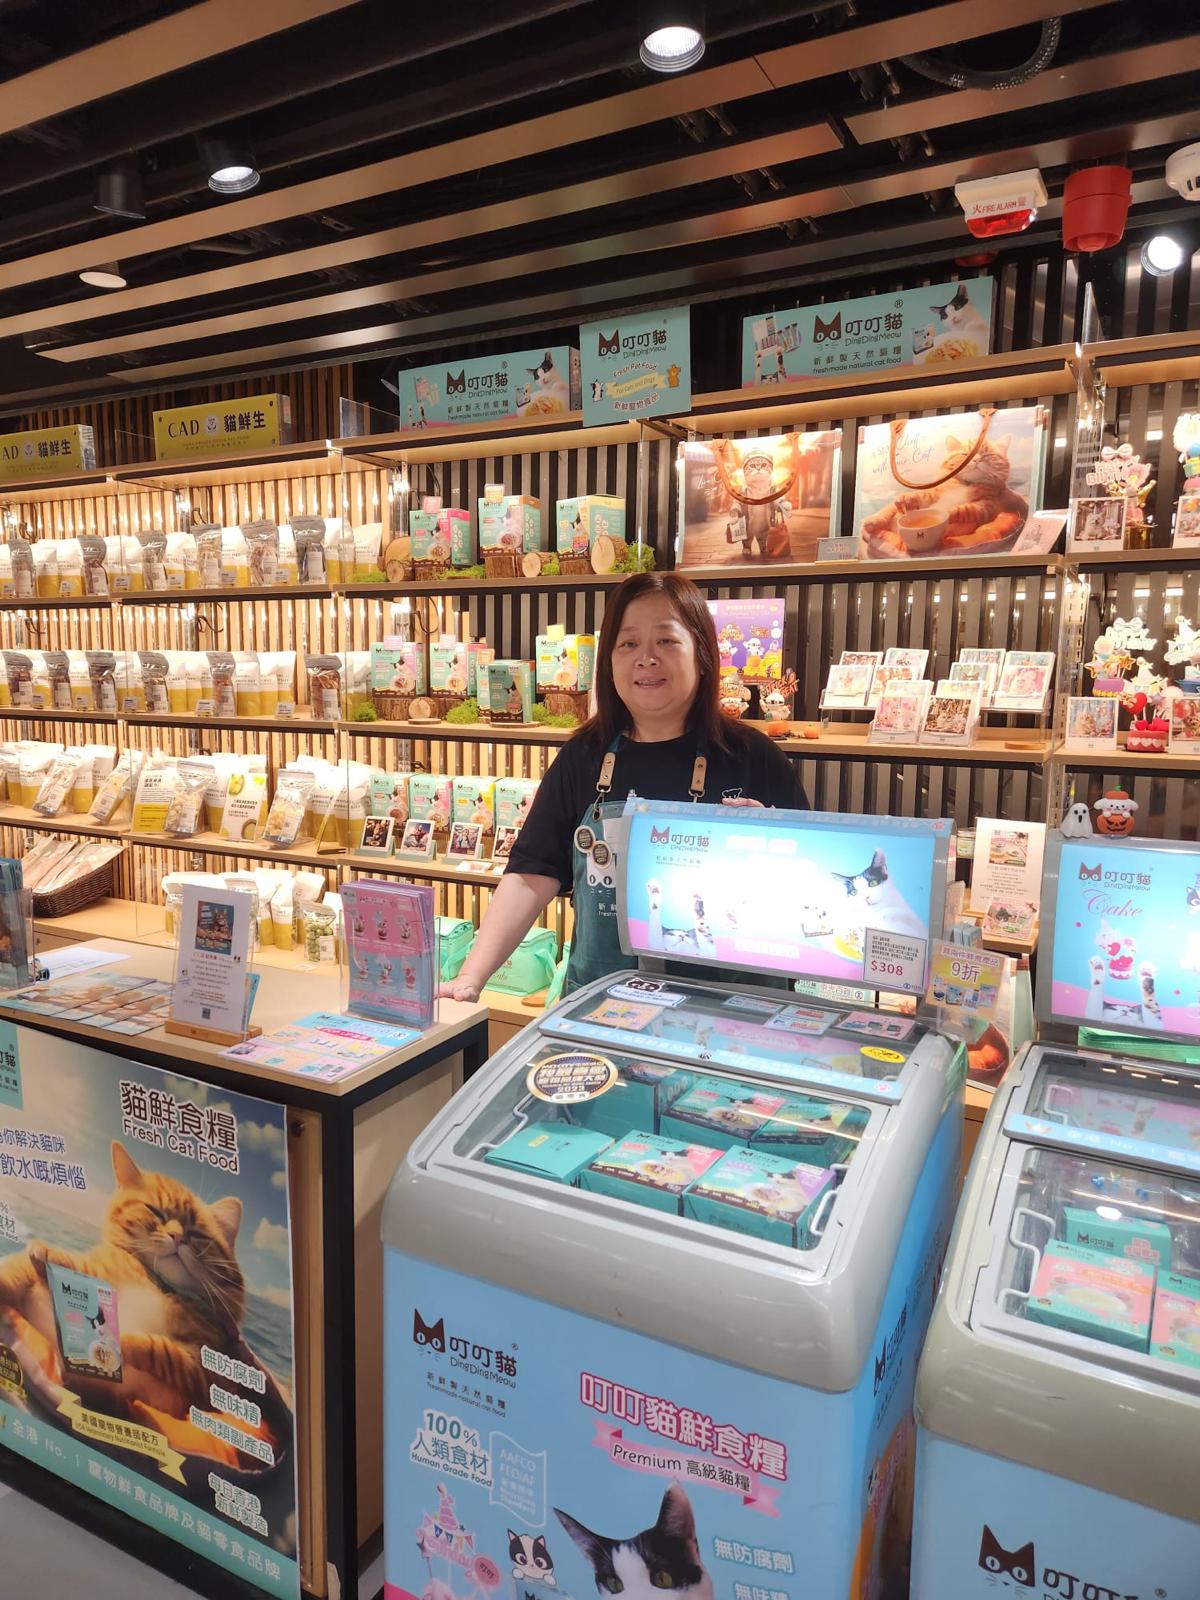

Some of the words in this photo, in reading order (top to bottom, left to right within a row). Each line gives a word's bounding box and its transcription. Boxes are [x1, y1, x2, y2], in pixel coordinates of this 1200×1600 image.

[982, 204, 996, 212] FIRE
[996, 201, 1017, 211] ALARM
[845, 312, 903, 336] 叮叮貓
[622, 328, 667, 349] 叮叮貓
[845, 332, 902, 346] DingDingMeow
[613, 366, 630, 377] Fresh
[630, 362, 641, 371] Pet
[813, 363, 848, 374] freshmade
[849, 360, 873, 369] natural
[874, 358, 884, 366] cat
[886, 356, 902, 364] food
[467, 371, 508, 390] 叮叮貓
[167, 419, 200, 439] CAD
[223, 410, 267, 433] 貓鮮生
[38, 439, 72, 458] 貓鮮生
[671, 833, 710, 847] 叮叮貓
[1104, 871, 1152, 886] 叮叮貓
[1083, 888, 1144, 918] Cake
[871, 959, 903, 976] $308
[951, 962, 981, 984] 9折
[558, 1085, 585, 1093] 2023
[120, 1081, 238, 1153] 貓鮮食糧
[123, 1119, 162, 1146] Fresh
[167, 1133, 193, 1157] Cat
[198, 1144, 239, 1172] Food
[450, 1336, 517, 1376] 叮叮貓
[202, 1348, 265, 1392] 無防腐劑
[450, 1357, 516, 1389] DingDingMeow
[210, 1386, 261, 1427] 無味精
[12, 1418, 38, 1445] 全港
[45, 1437, 67, 1459] No.
[191, 1406, 275, 1465] 無肉類副產品
[426, 1413, 478, 1448] 100%
[581, 1372, 787, 1481] 叮叮貓鮮食糧
[413, 1432, 489, 1476] 人類食材
[411, 1452, 440, 1469] Human
[442, 1462, 469, 1480] Grade
[471, 1473, 492, 1488] Food
[613, 1444, 682, 1471] Premium
[686, 1460, 751, 1492] 高級貓糧
[715, 1537, 793, 1574] 無防腐劑
